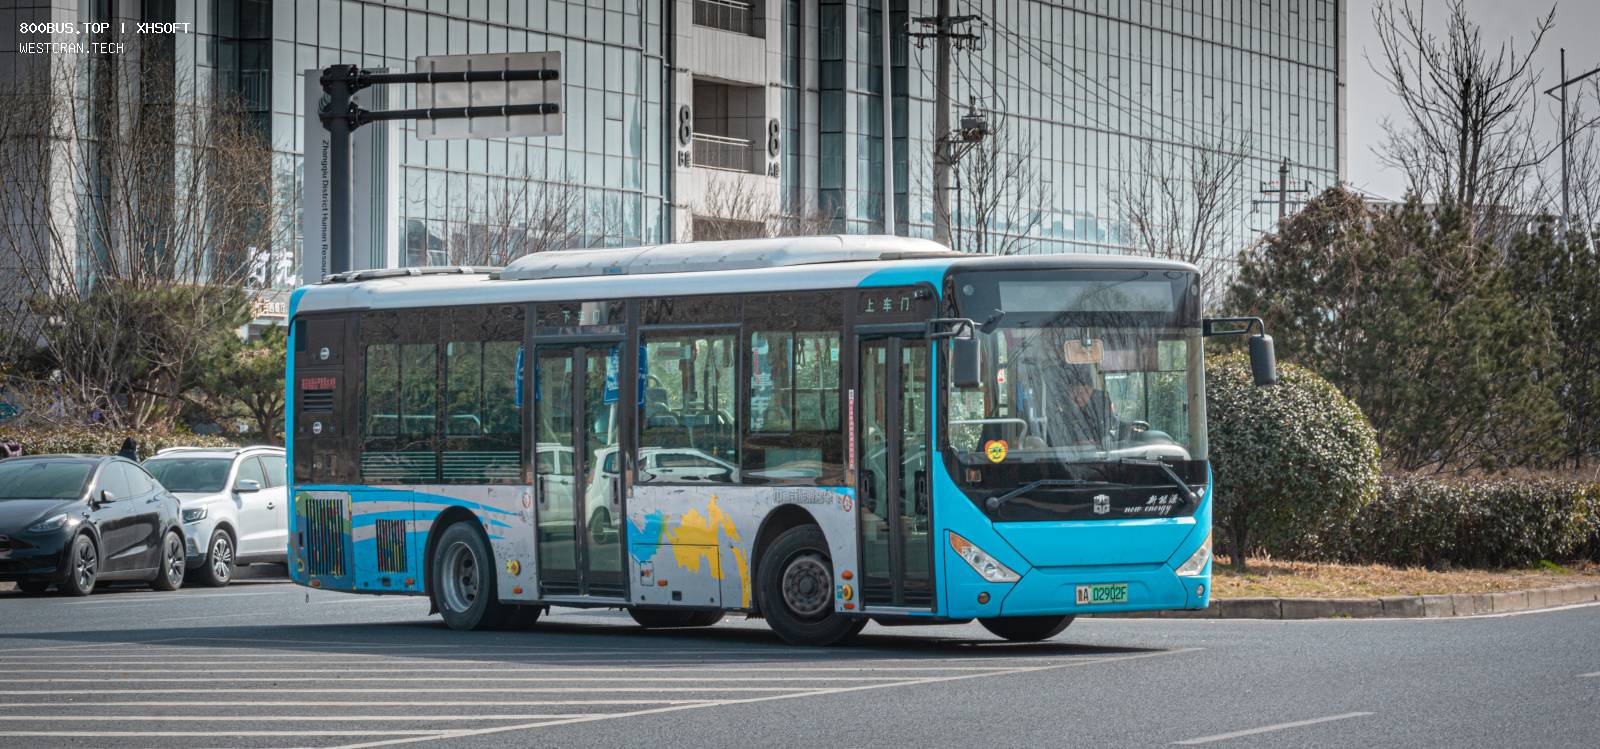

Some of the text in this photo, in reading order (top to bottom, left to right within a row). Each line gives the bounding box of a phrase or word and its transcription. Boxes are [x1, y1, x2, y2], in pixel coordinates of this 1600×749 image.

[679, 105, 691, 147] 8
[769, 118, 780, 158] 8
[320, 139, 329, 180] Zhangqiu
[320, 180, 329, 211] District
[320, 213, 329, 242] Human
[864, 296, 910, 312] 上车门
[1144, 504, 1172, 515] energy
